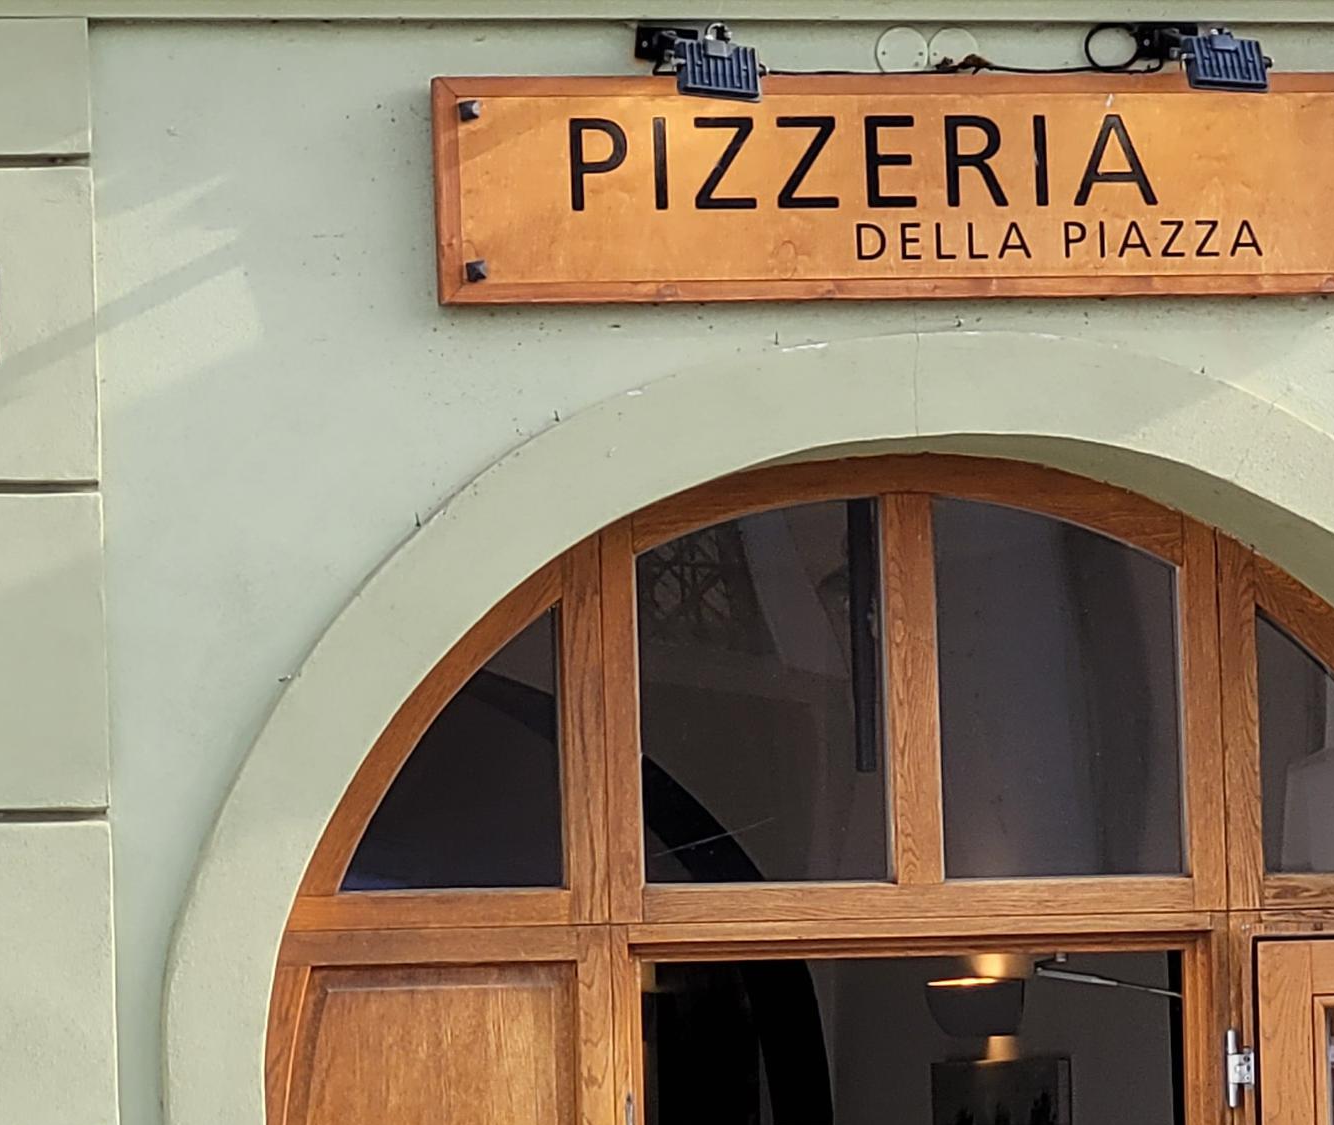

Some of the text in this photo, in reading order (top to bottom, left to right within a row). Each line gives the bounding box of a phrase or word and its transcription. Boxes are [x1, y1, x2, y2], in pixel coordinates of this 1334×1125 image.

[568, 113, 1158, 211] PIZZERIA
[855, 219, 1264, 260] DELLA PIAZZA
